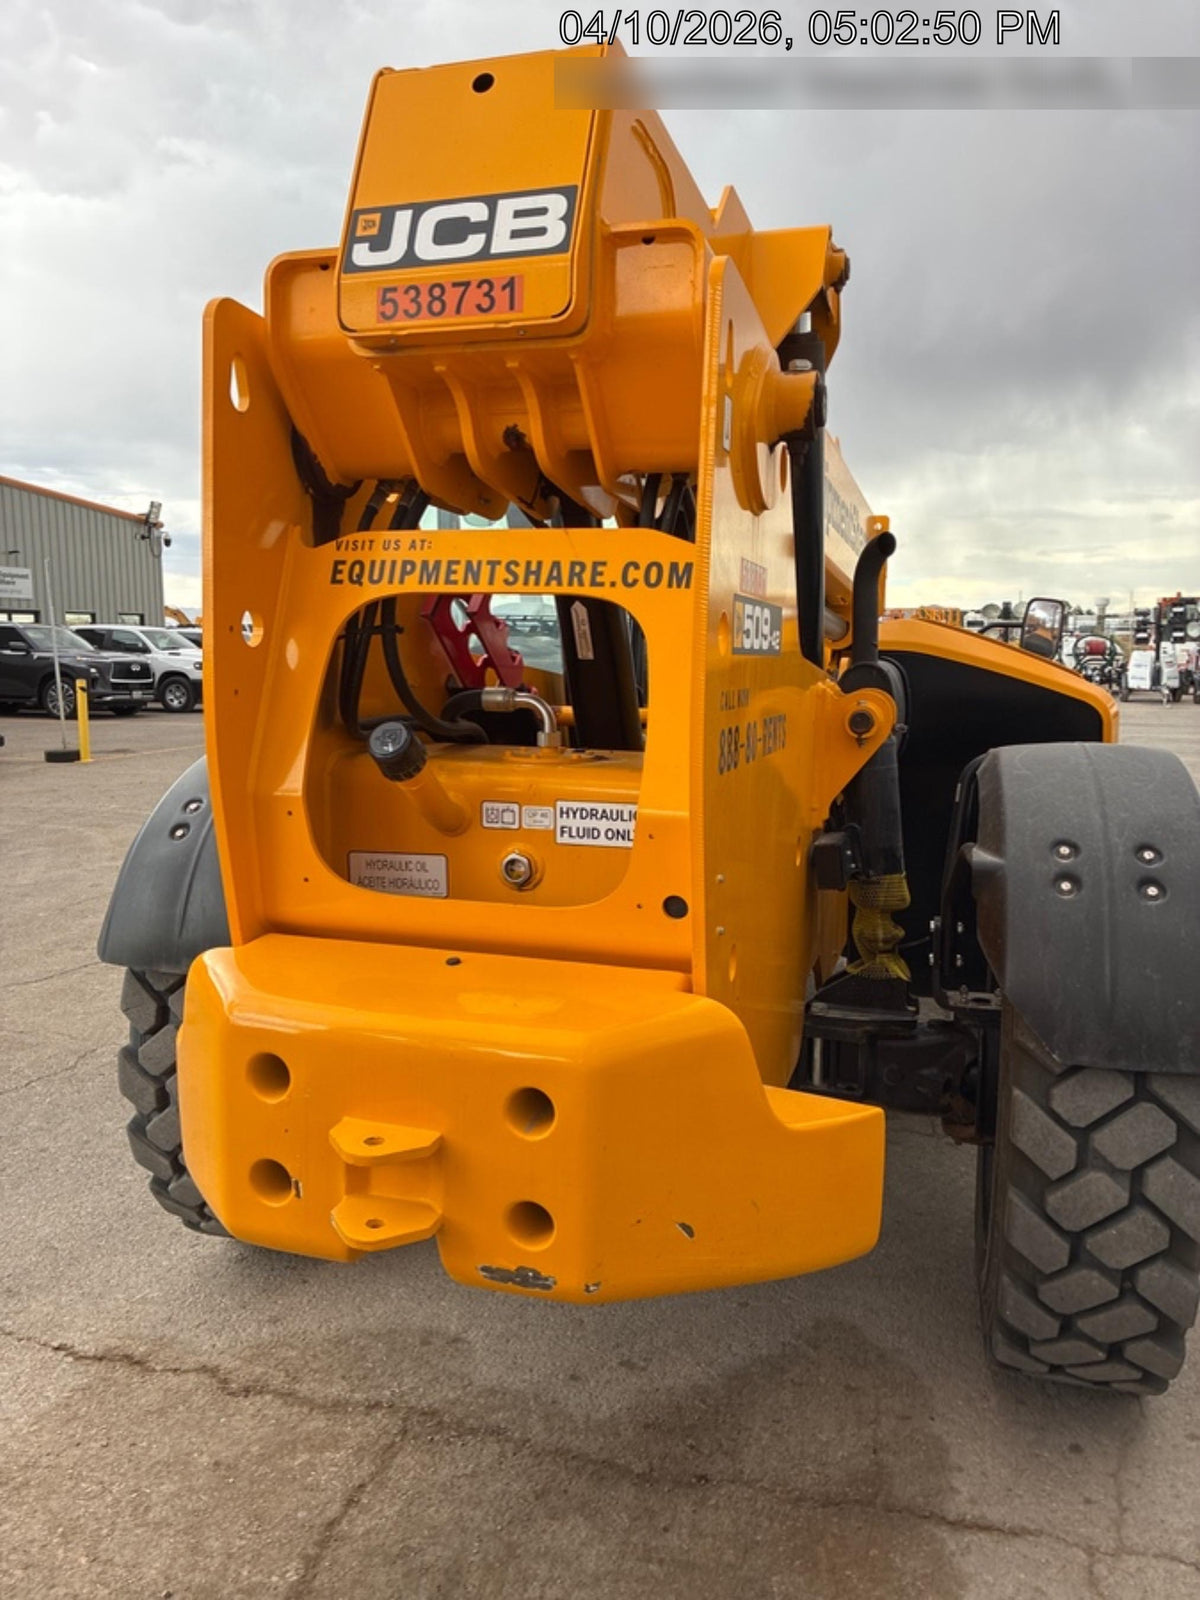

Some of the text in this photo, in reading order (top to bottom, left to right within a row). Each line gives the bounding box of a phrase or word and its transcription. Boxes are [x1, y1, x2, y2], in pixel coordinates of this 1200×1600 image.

[351, 193, 569, 267] JCB
[379, 276, 517, 321] 538731
[335, 539, 433, 551] VISIT US AT:
[330, 559, 694, 589] EQUIPMENTSHARE.COM
[560, 826, 635, 842] FLUID ONL
[365, 860, 429, 873] HYDRAULIC OIL
